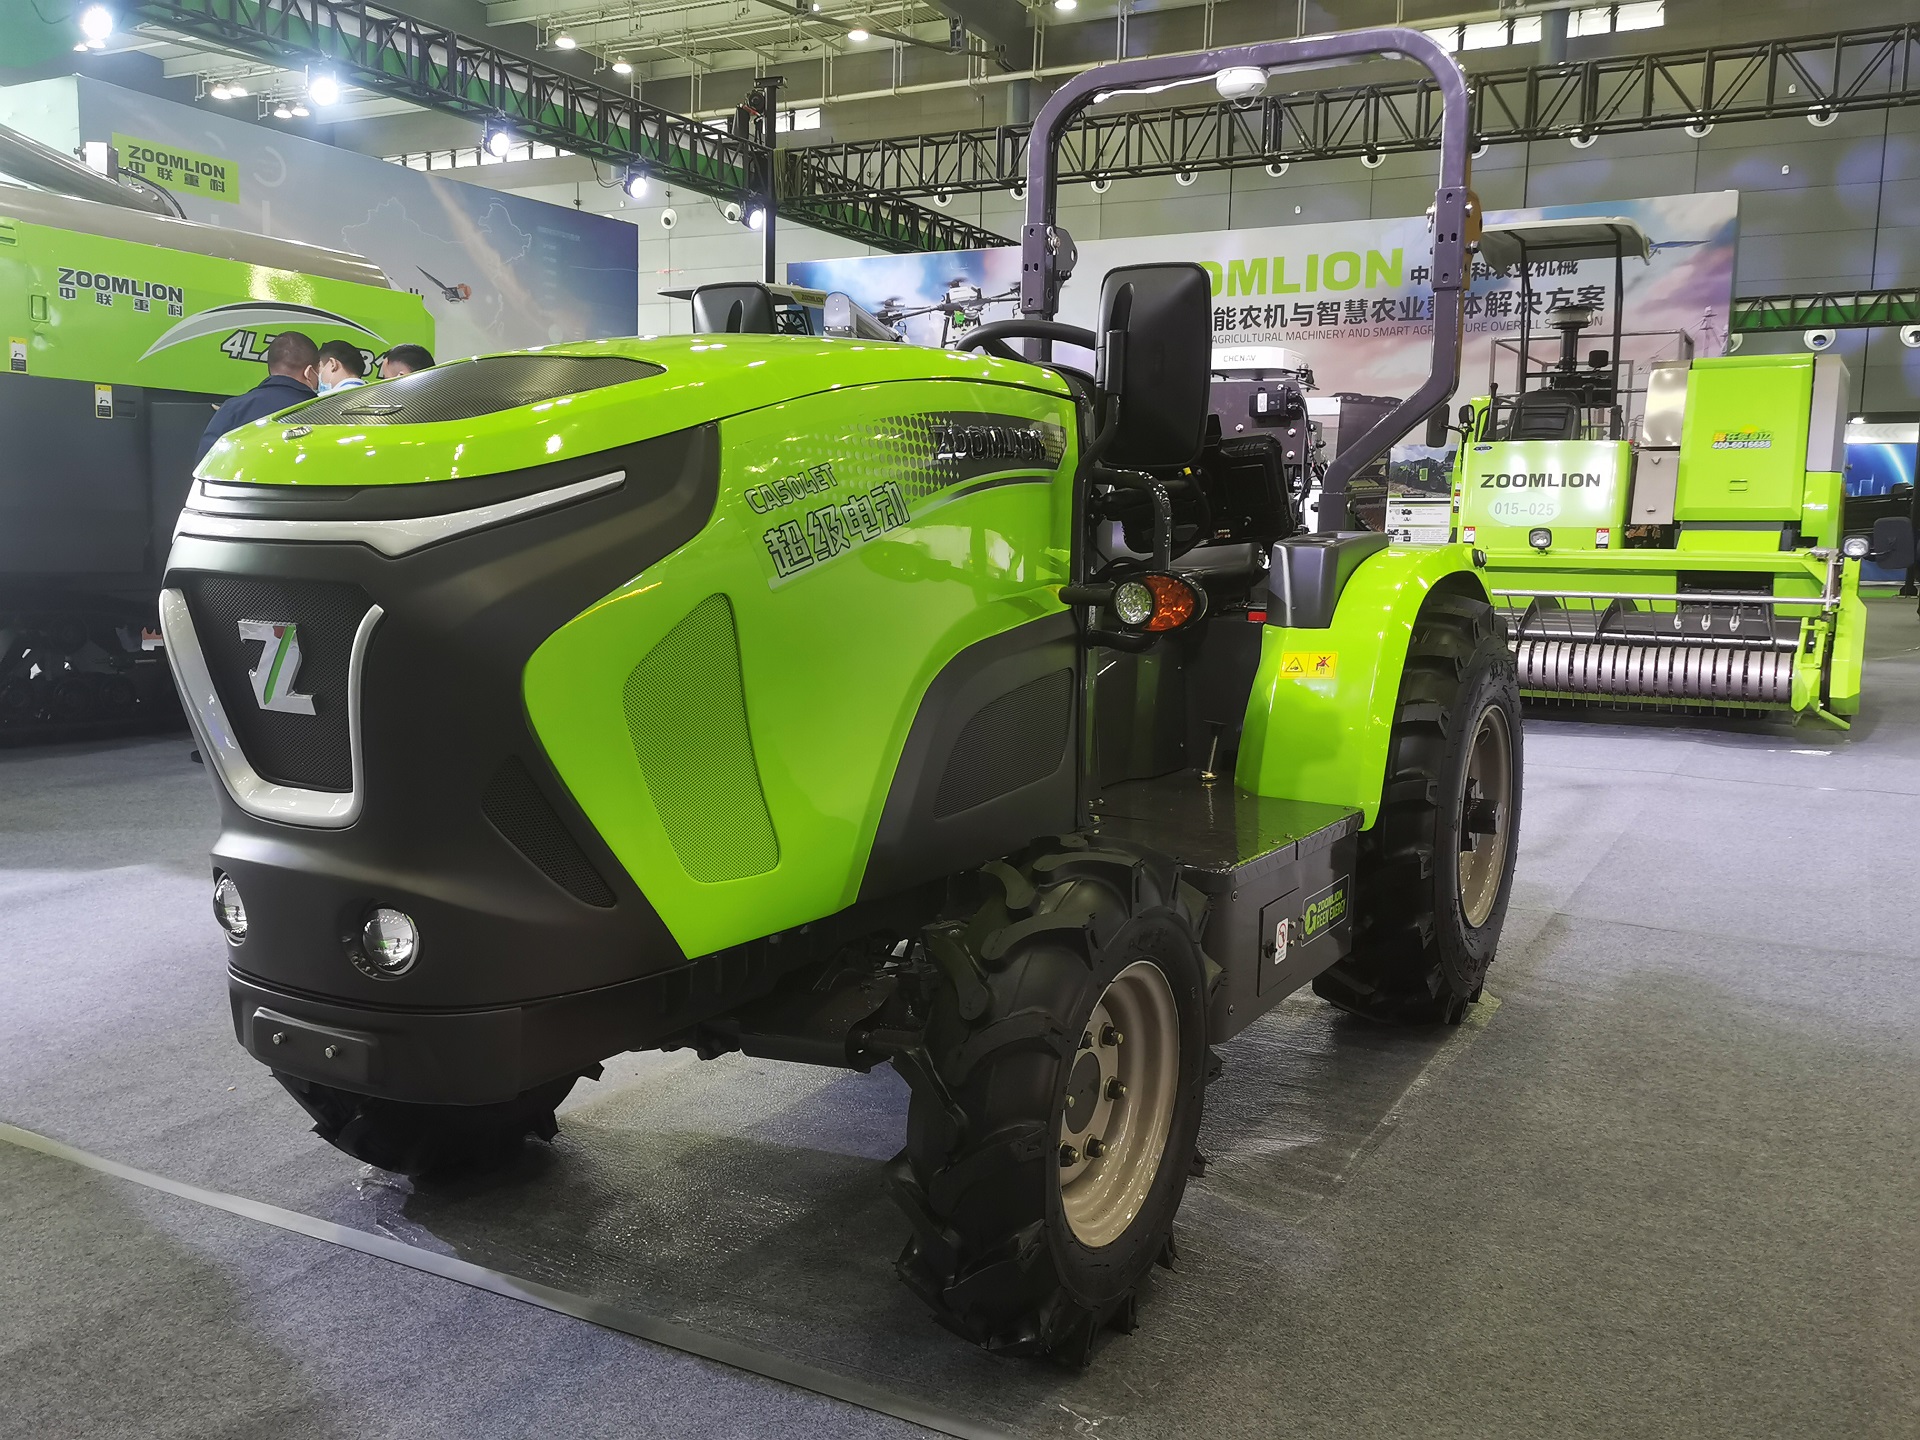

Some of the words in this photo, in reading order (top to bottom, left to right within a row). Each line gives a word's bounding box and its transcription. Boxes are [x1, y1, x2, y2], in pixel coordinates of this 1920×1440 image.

[128, 144, 225, 179] ZOOMLION
[58, 267, 183, 303] ZOOMLION
[1212, 333, 1283, 345] AGRICULTURAL
[1285, 330, 1345, 341] MACHINERY
[1348, 328, 1370, 338] AND
[1373, 326, 1414, 337] SMART
[744, 462, 839, 515] CA504ET
[1480, 473, 1601, 489] ZOOMLION
[1494, 502, 1555, 516] 015-025
[763, 481, 912, 579] 超级电动
